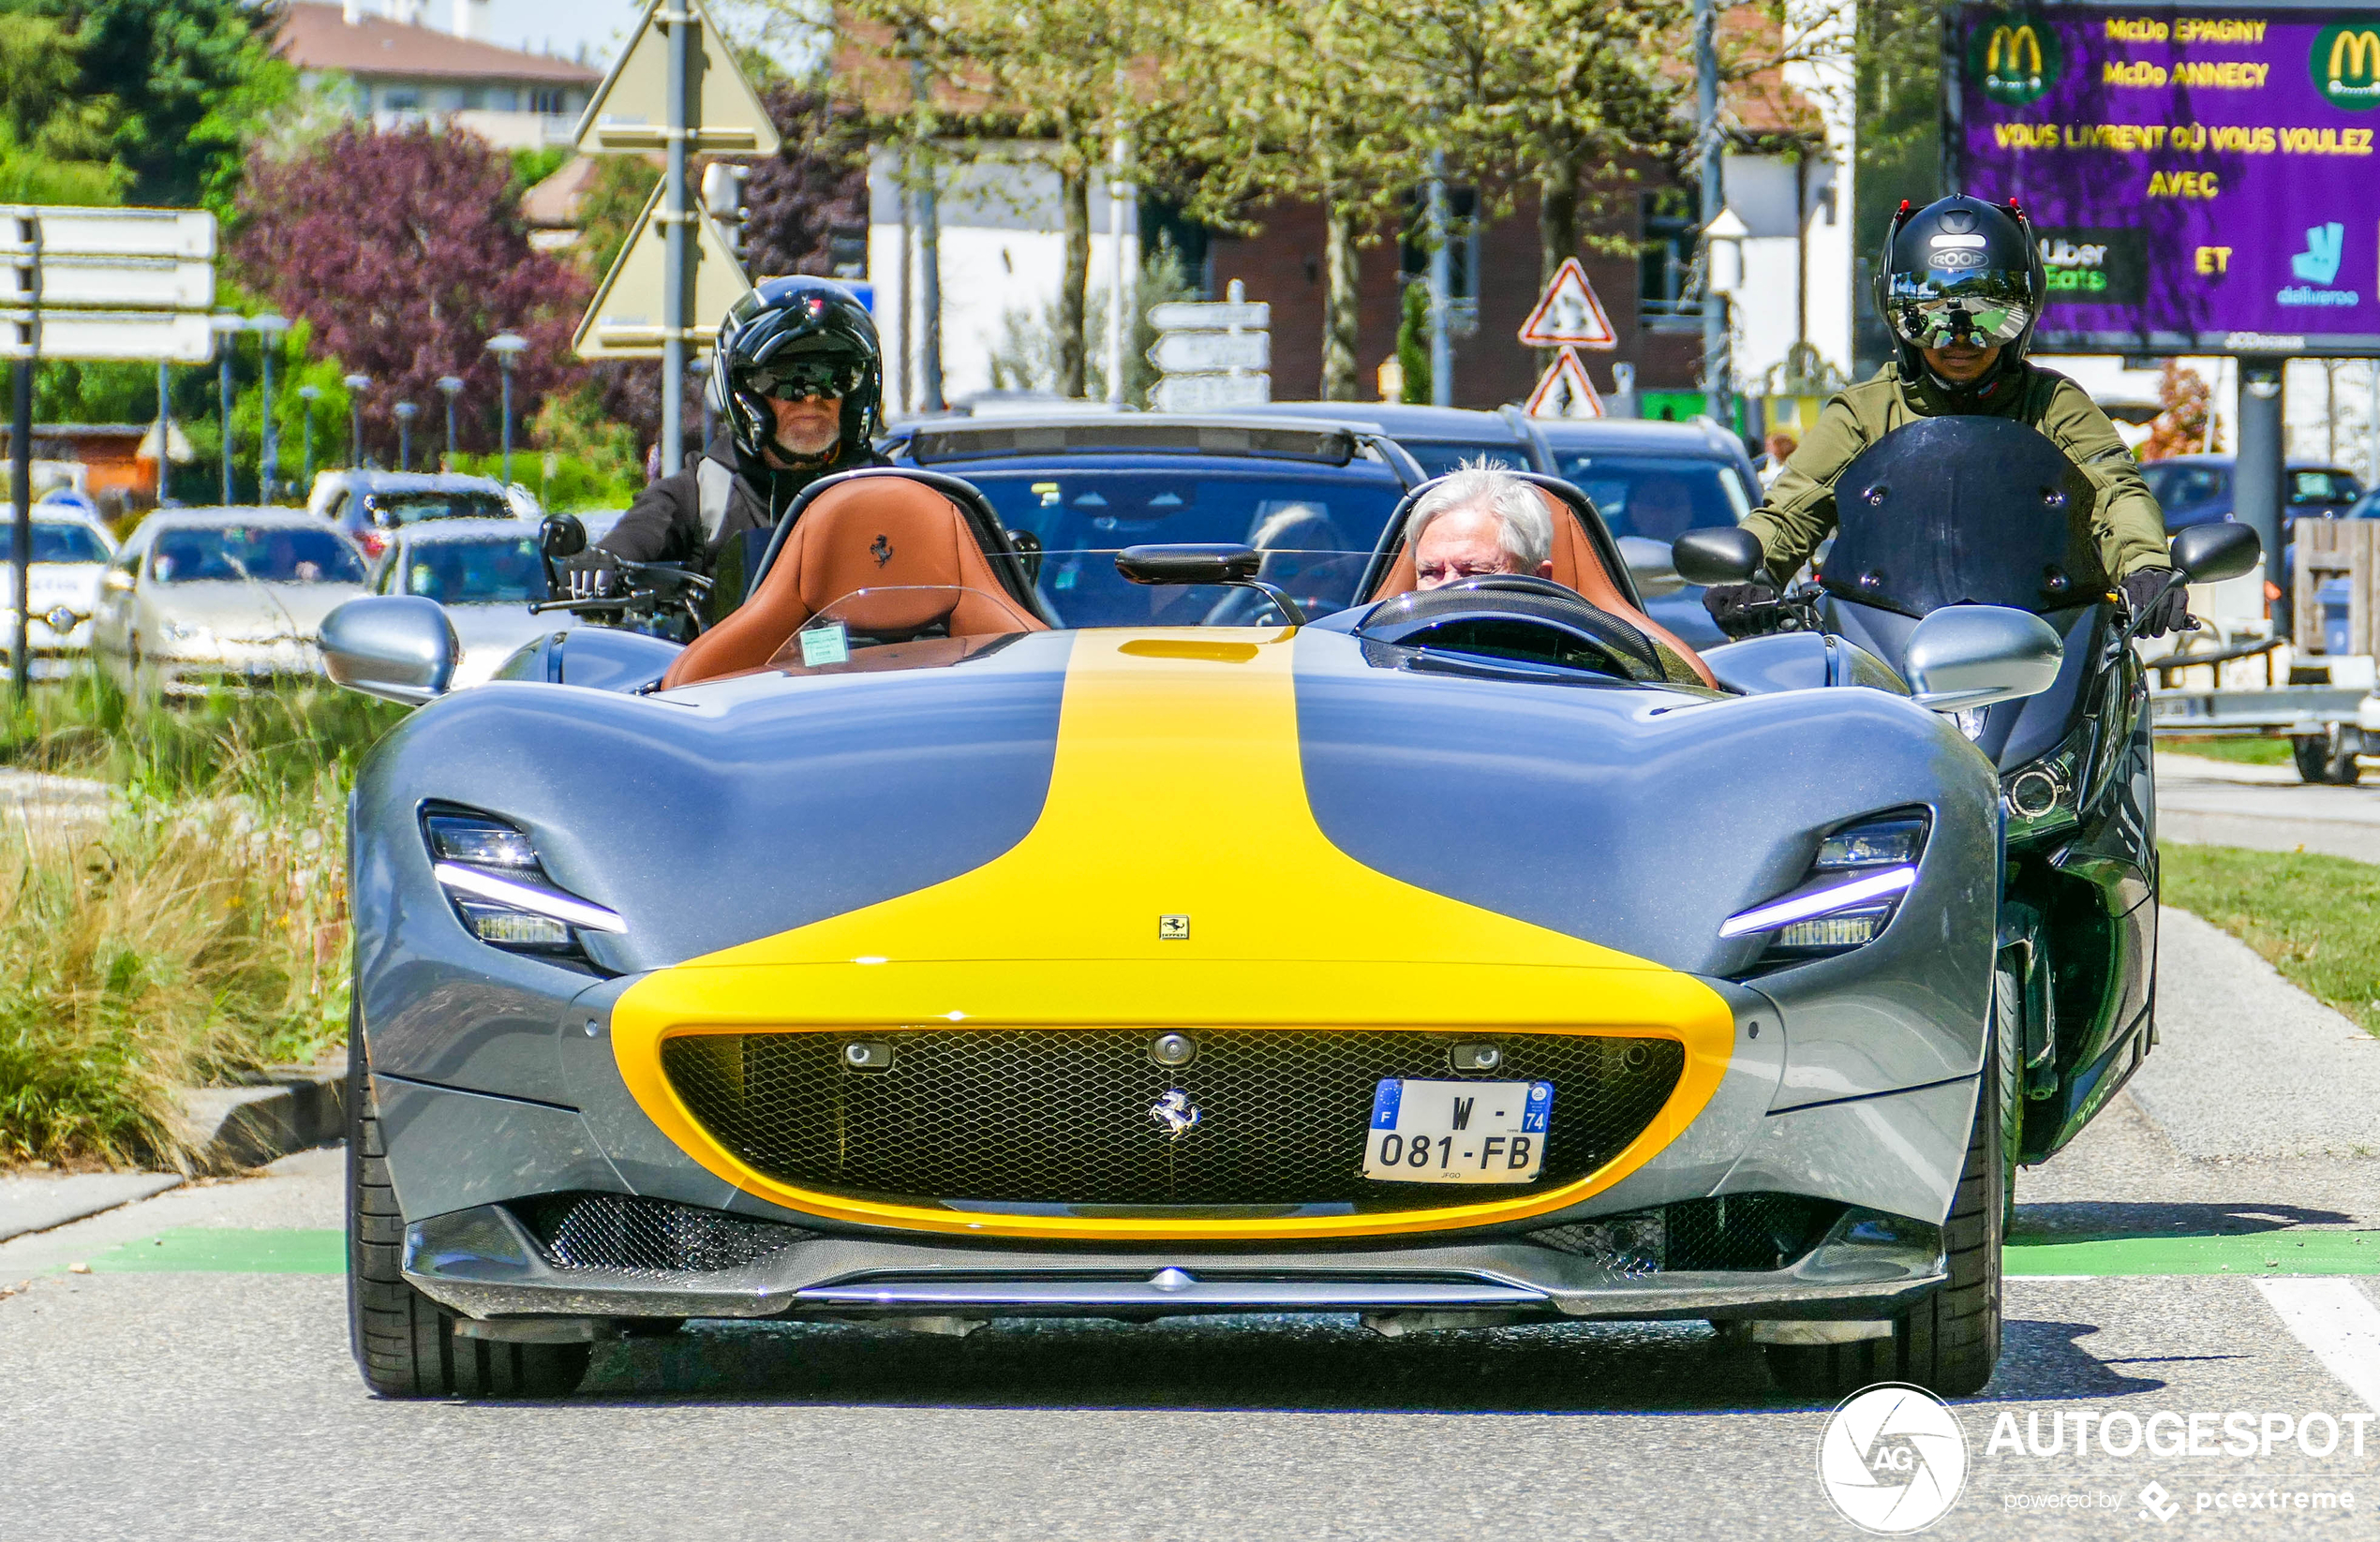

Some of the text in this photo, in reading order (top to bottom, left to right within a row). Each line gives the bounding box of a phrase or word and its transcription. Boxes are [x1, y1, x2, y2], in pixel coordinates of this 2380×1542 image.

[2105, 17, 2268, 43] McDo EPAGNY
[2103, 61, 2269, 89] McDo ANNECY
[1994, 122, 2373, 154] VOUS LIVRENT OÙ VOUS VOULEZ
[2147, 171, 2220, 198] AVEC
[1933, 252, 1984, 266] ROOF
[2040, 238, 2107, 266] Uber
[2195, 246, 2232, 274] ET
[2045, 264, 2107, 291] Eats
[1380, 1111, 1391, 1123] F
[1452, 1097, 1474, 1131] W
[1525, 1113, 1544, 1130] 74
[1379, 1134, 1531, 1170] 081-FB
